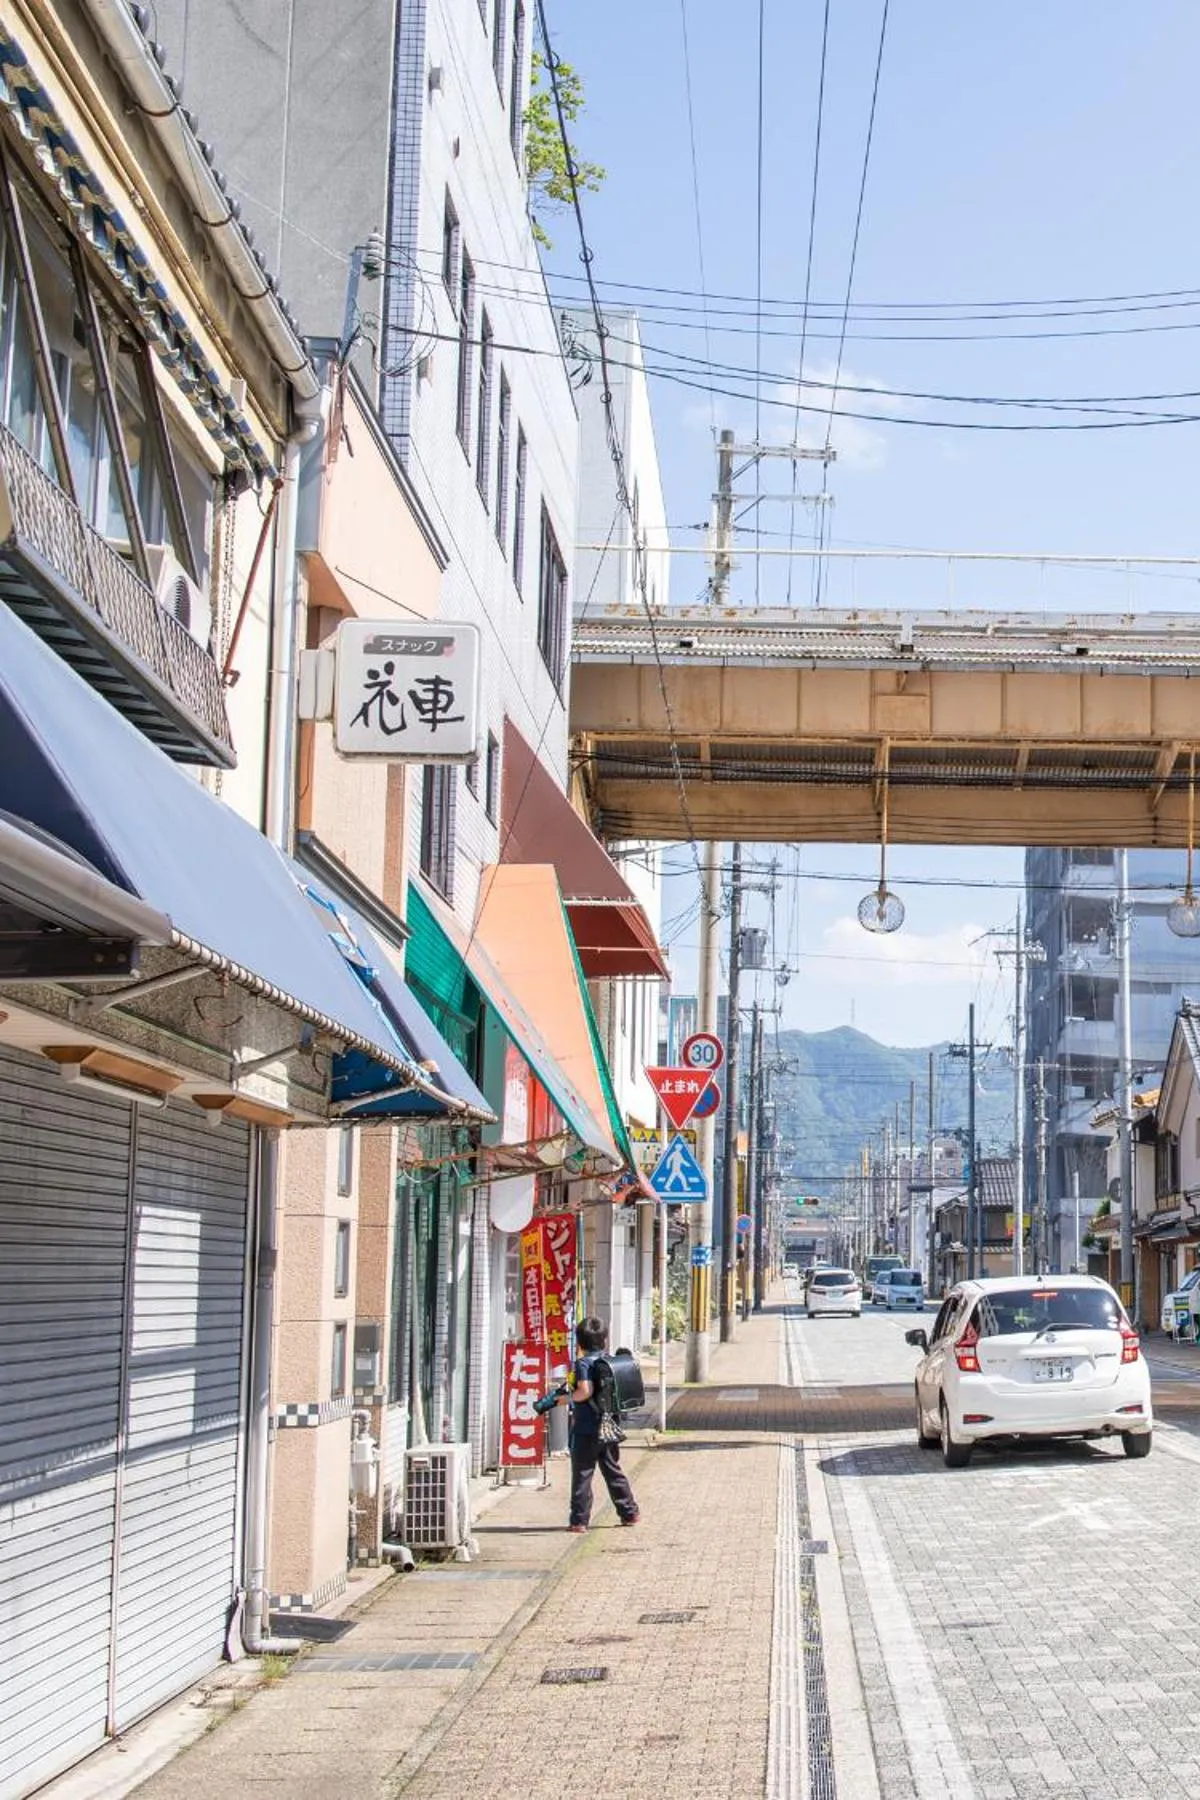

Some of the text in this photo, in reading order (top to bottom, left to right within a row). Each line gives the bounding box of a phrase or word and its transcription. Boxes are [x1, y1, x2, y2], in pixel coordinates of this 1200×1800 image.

[381, 639, 437, 652] スナック
[350, 661, 465, 735] 花車
[691, 1045, 715, 1062] 30
[660, 1079, 700, 1093] 止まれ
